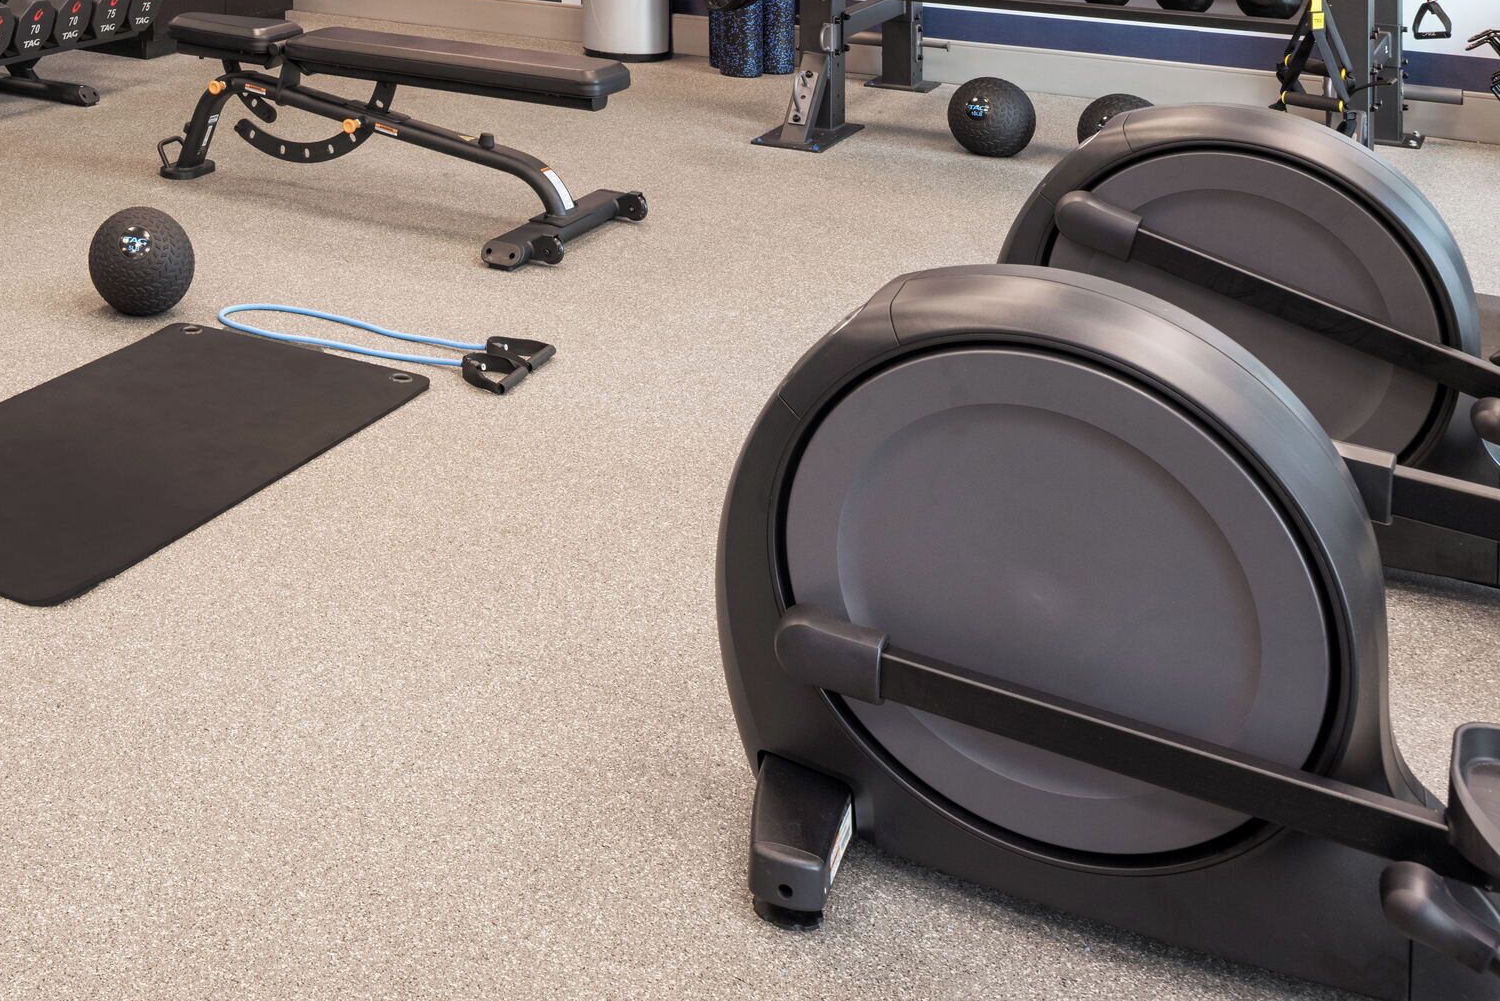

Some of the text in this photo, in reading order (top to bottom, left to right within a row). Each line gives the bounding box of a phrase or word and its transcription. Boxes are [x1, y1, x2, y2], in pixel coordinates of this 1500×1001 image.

[141, 1, 152, 12] 75
[106, 8, 116, 19] 75
[68, 15, 79, 27] 70
[135, 16, 150, 25] TAG
[30, 24, 41, 35] 70
[100, 23, 116, 33] TAG
[61, 29, 79, 40] TAG
[23, 38, 41, 49] TAG
